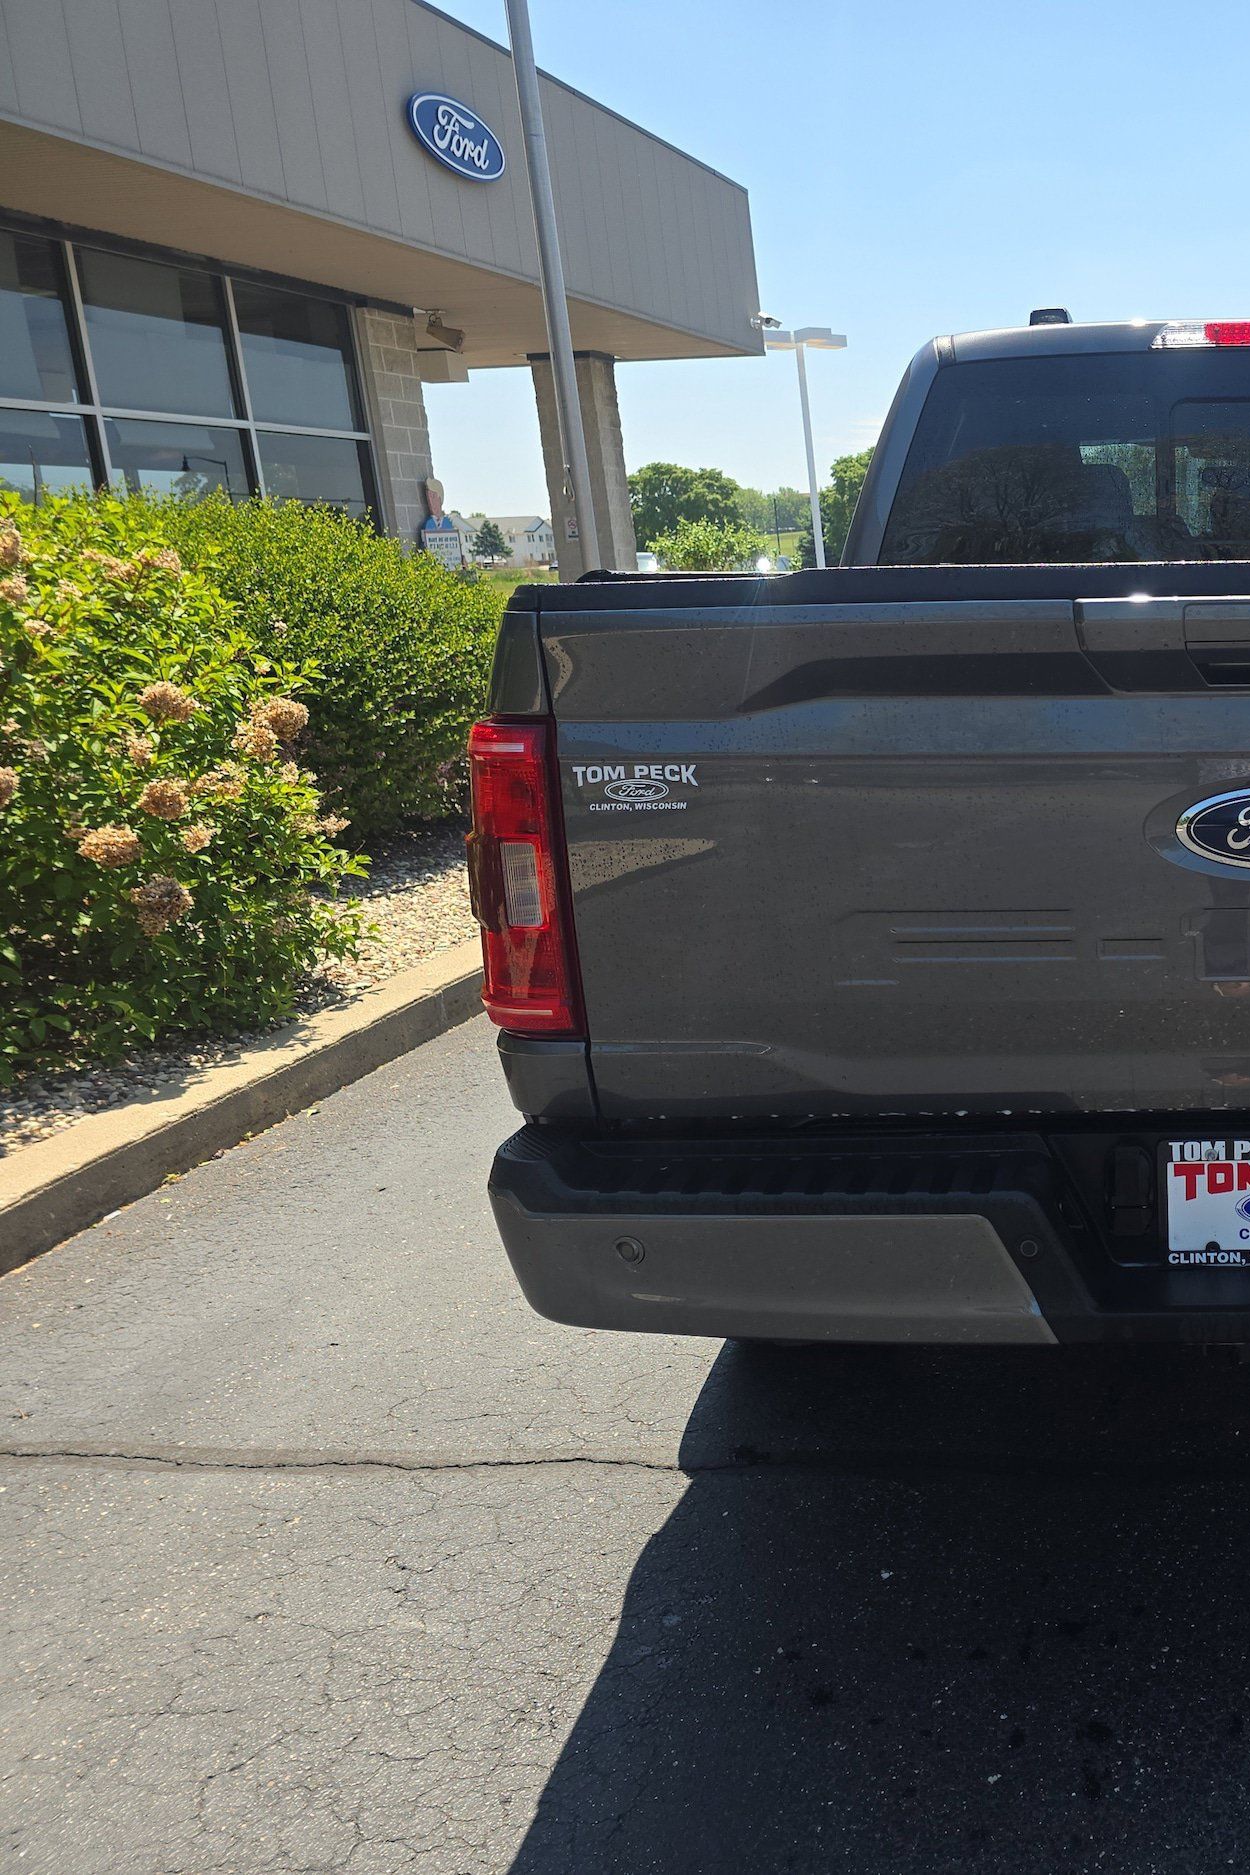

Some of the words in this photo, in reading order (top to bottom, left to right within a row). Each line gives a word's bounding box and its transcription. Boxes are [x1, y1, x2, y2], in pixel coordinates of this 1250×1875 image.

[433, 104, 489, 170] Ford
[572, 765, 626, 788] TOM
[634, 764, 699, 788] PECK
[618, 783, 657, 797] Ford
[589, 802, 633, 812] CLINTON,
[634, 802, 687, 811] WISCONSIN
[1168, 1140, 1226, 1162] TOM
[1167, 1251, 1246, 1266] CLINTON,
